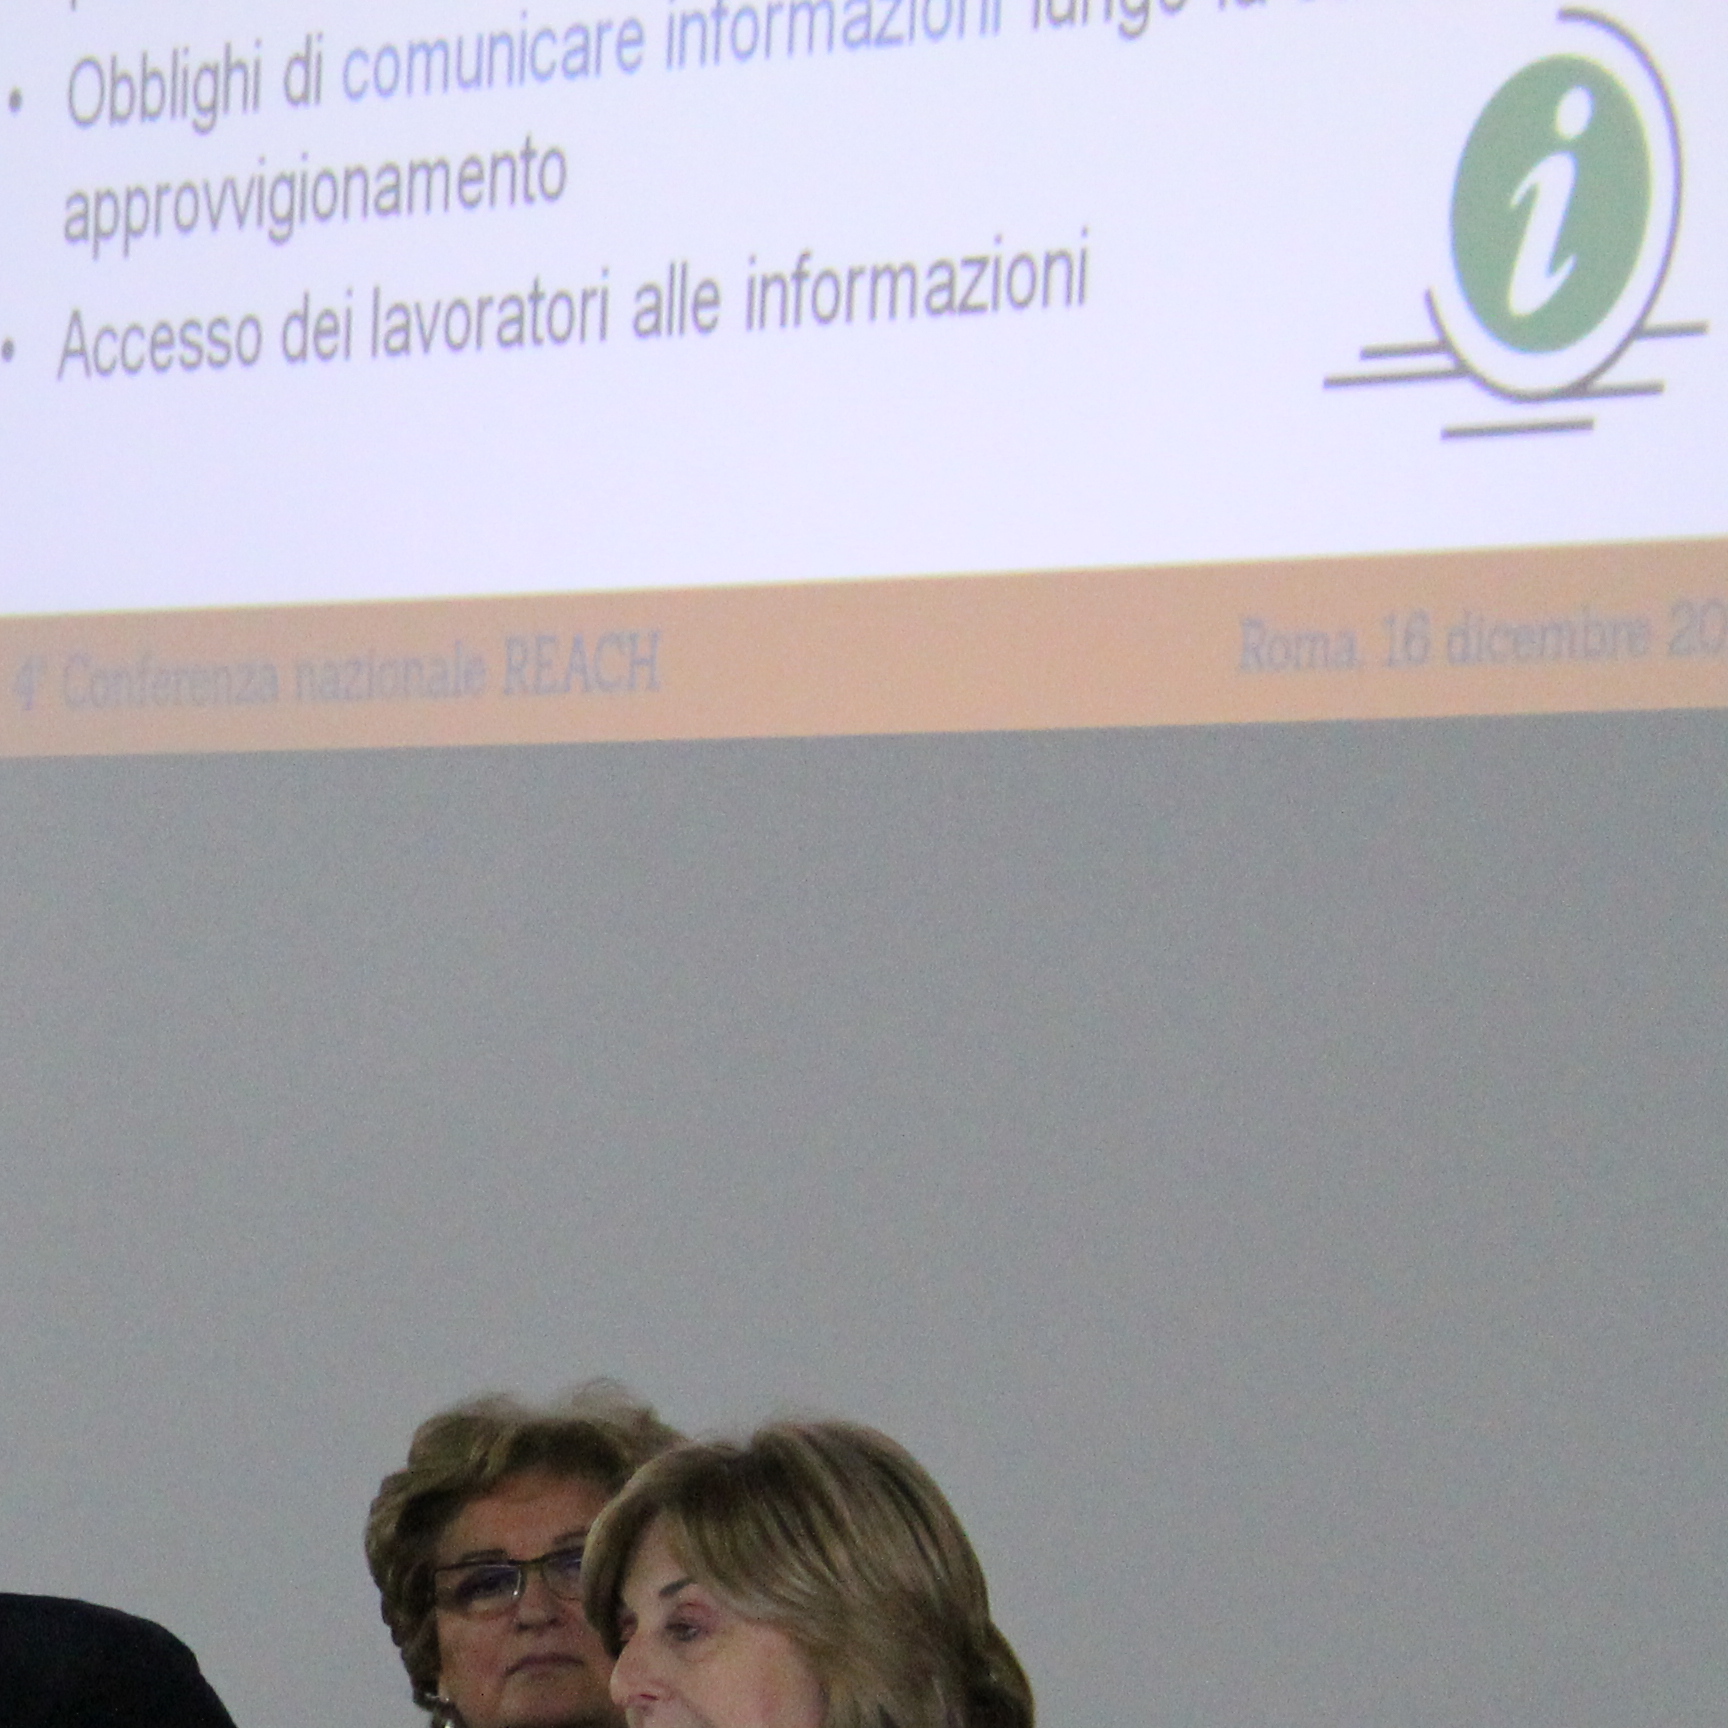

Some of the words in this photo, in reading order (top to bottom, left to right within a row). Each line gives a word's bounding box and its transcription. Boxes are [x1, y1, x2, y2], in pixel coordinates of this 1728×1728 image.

[67, 40, 261, 136] Obblighi
[283, 33, 323, 108] di
[343, 8, 645, 102] comunicare
[63, 132, 568, 261] approvvigionamento
[57, 308, 263, 381] Accesso
[282, 289, 352, 364] dei
[371, 266, 609, 359] lavoratori
[632, 260, 721, 340] alle
[746, 226, 1088, 331] informazioni
[61, 648, 280, 711] Conferenza
[294, 640, 487, 704] nazionale
[501, 629, 662, 696] REACH
[1382, 606, 1432, 668] 16
[1446, 607, 1651, 667] dicembre
